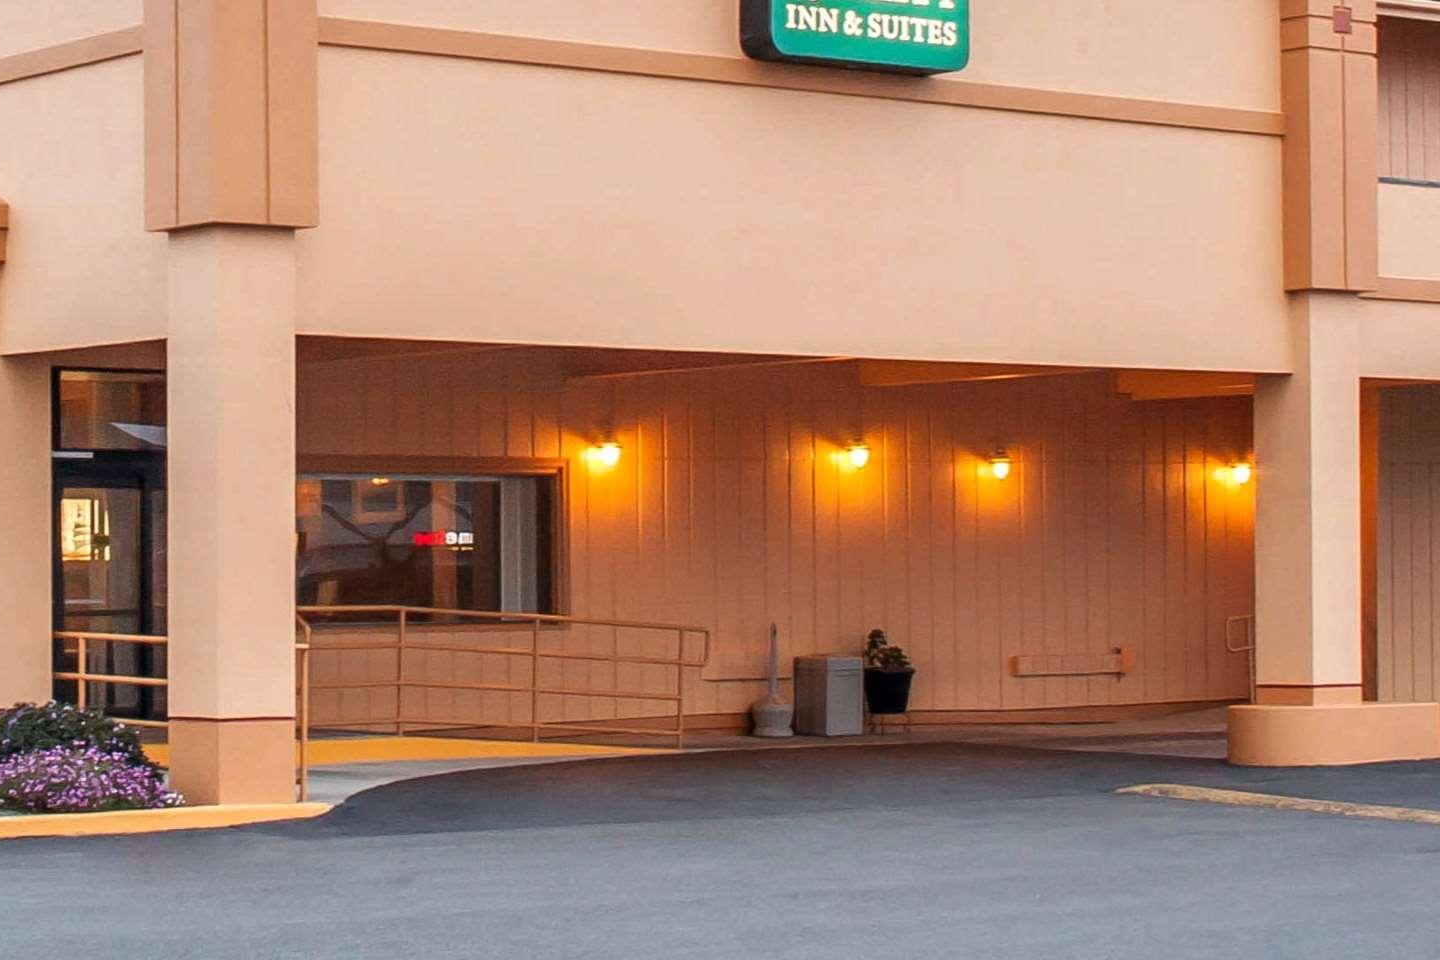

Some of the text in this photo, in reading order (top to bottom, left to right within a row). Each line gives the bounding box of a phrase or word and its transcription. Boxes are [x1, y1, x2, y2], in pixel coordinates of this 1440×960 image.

[785, 4, 957, 46] INN & SUITES
